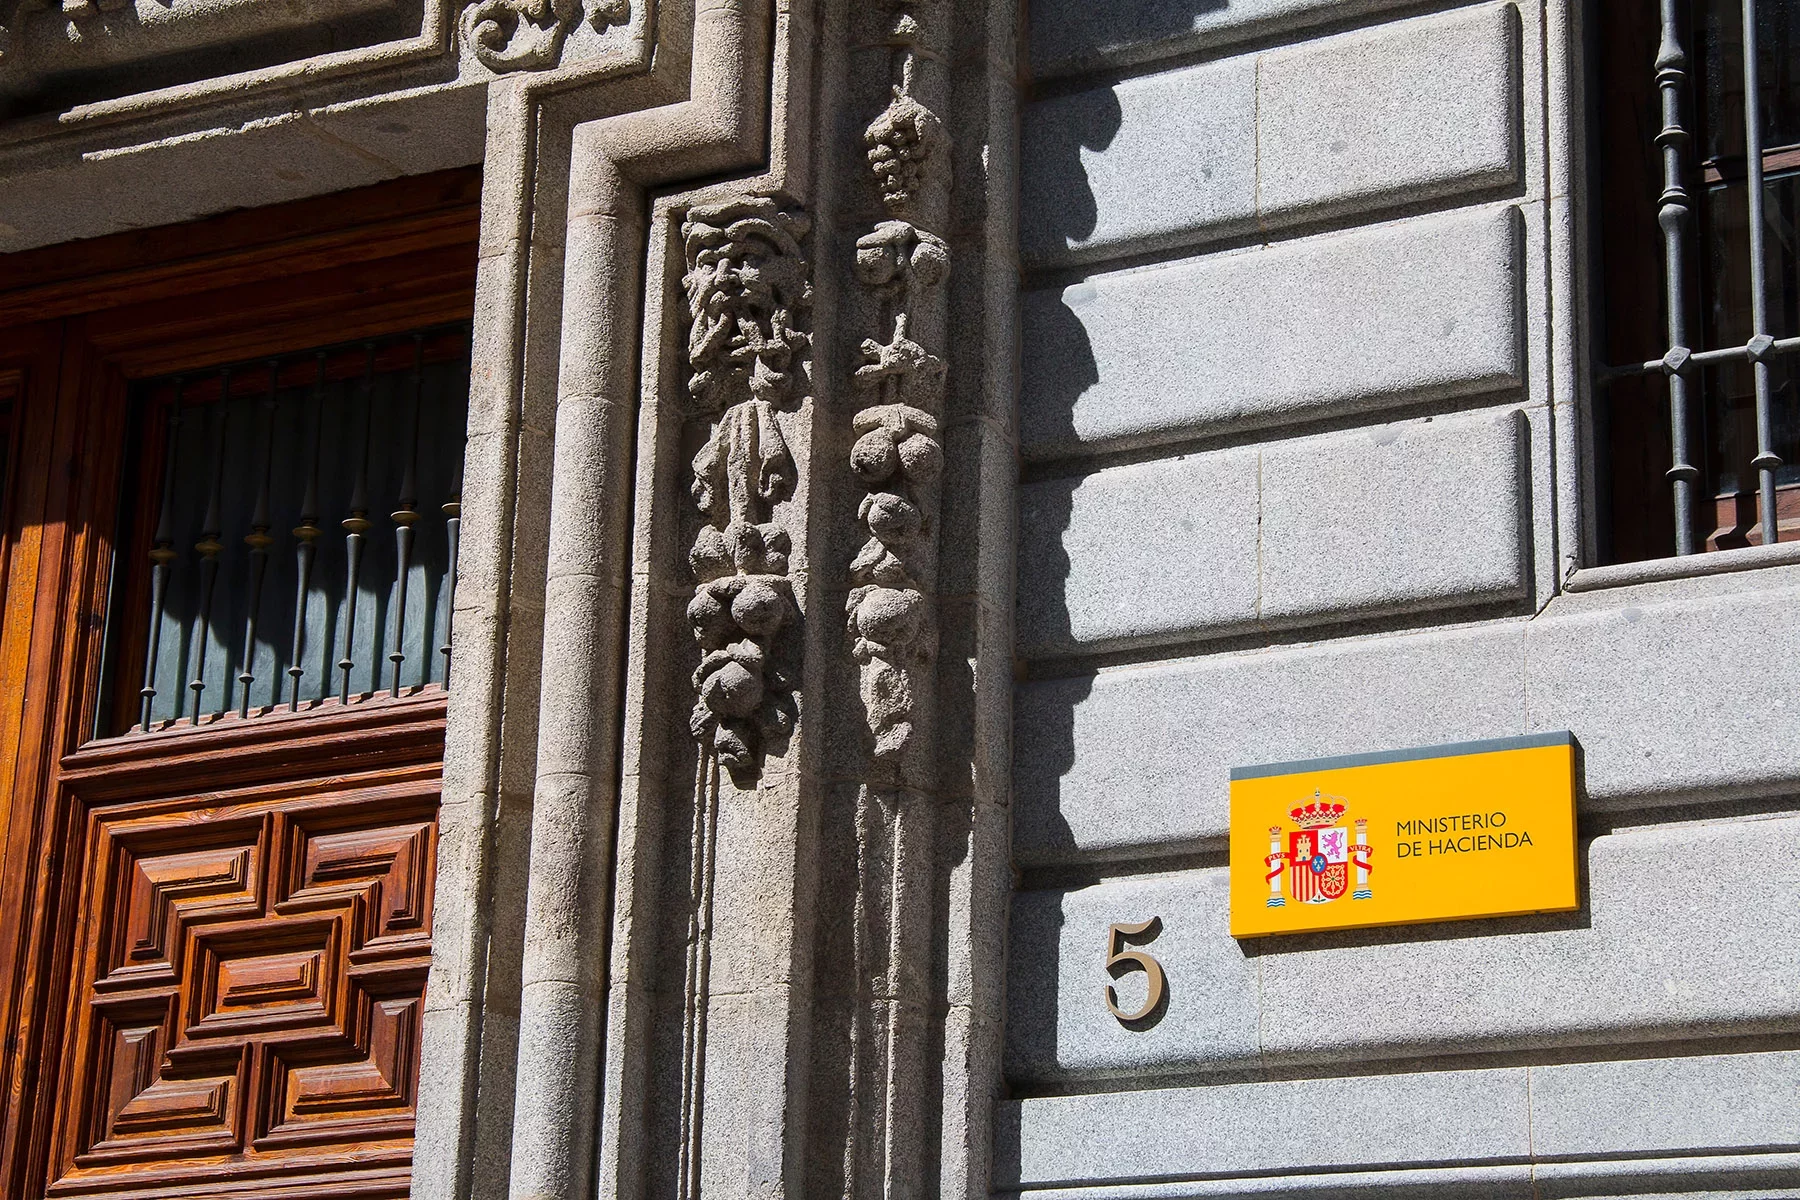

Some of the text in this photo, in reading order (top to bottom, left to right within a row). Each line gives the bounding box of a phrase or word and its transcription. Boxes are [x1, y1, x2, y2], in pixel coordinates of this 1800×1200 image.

[1396, 811, 1507, 837] MINISTERIO
[1349, 845, 1371, 853] VLTRA
[1397, 831, 1533, 858] DE HACIENDA
[1105, 915, 1164, 1021] 5
